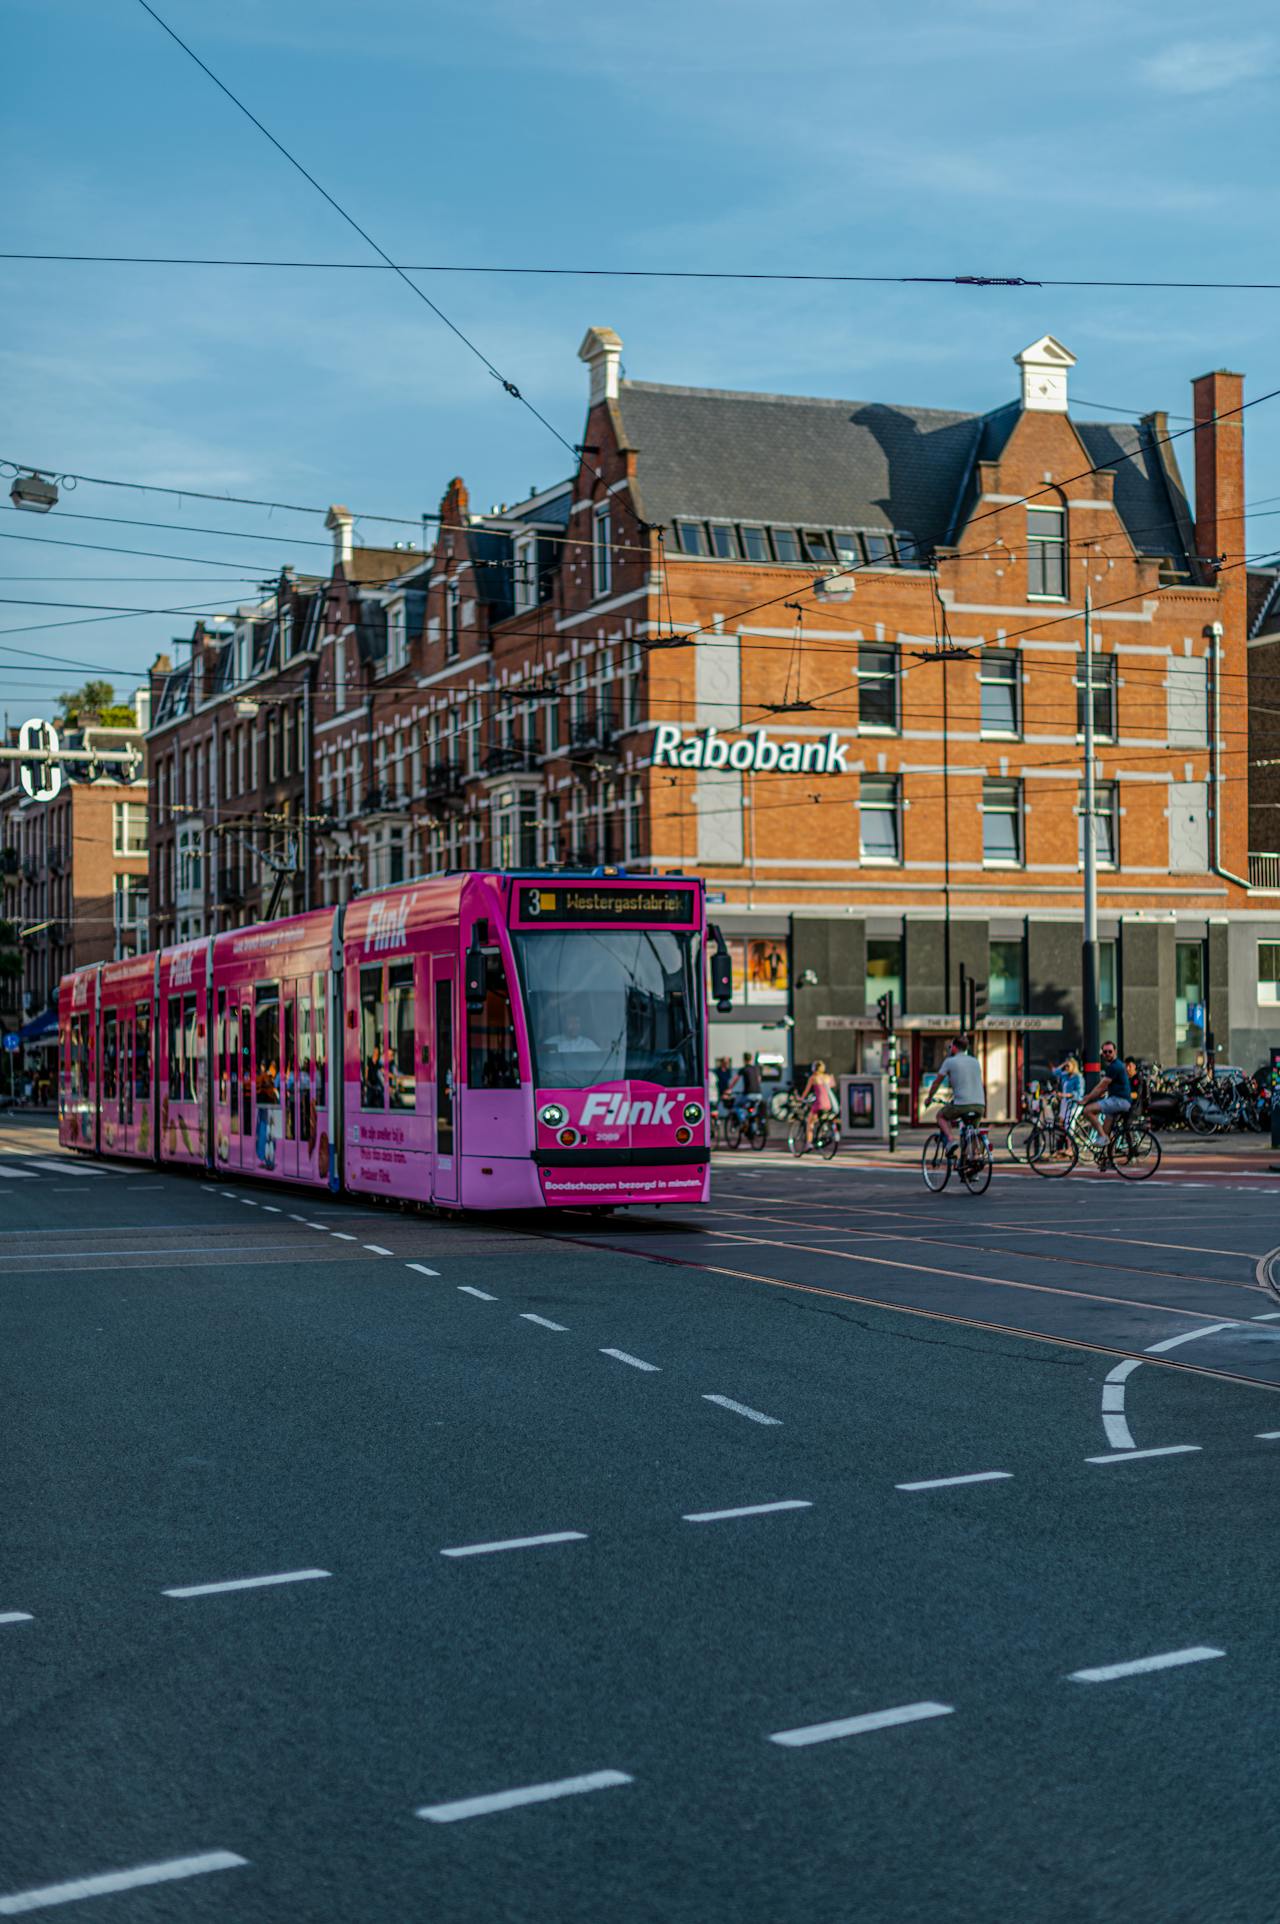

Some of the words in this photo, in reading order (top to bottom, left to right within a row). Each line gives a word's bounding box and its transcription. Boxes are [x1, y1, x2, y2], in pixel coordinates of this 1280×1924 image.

[652, 726, 850, 773] Rabobank
[528, 888, 540, 915] 3
[364, 892, 417, 953] Flink
[1024, 1018, 1042, 1028] GOD
[579, 1093, 686, 1126] Flink
[545, 1181, 617, 1191] Boodschappen
[618, 1180, 657, 1190] bezorgd
[658, 1180, 667, 1189] in
